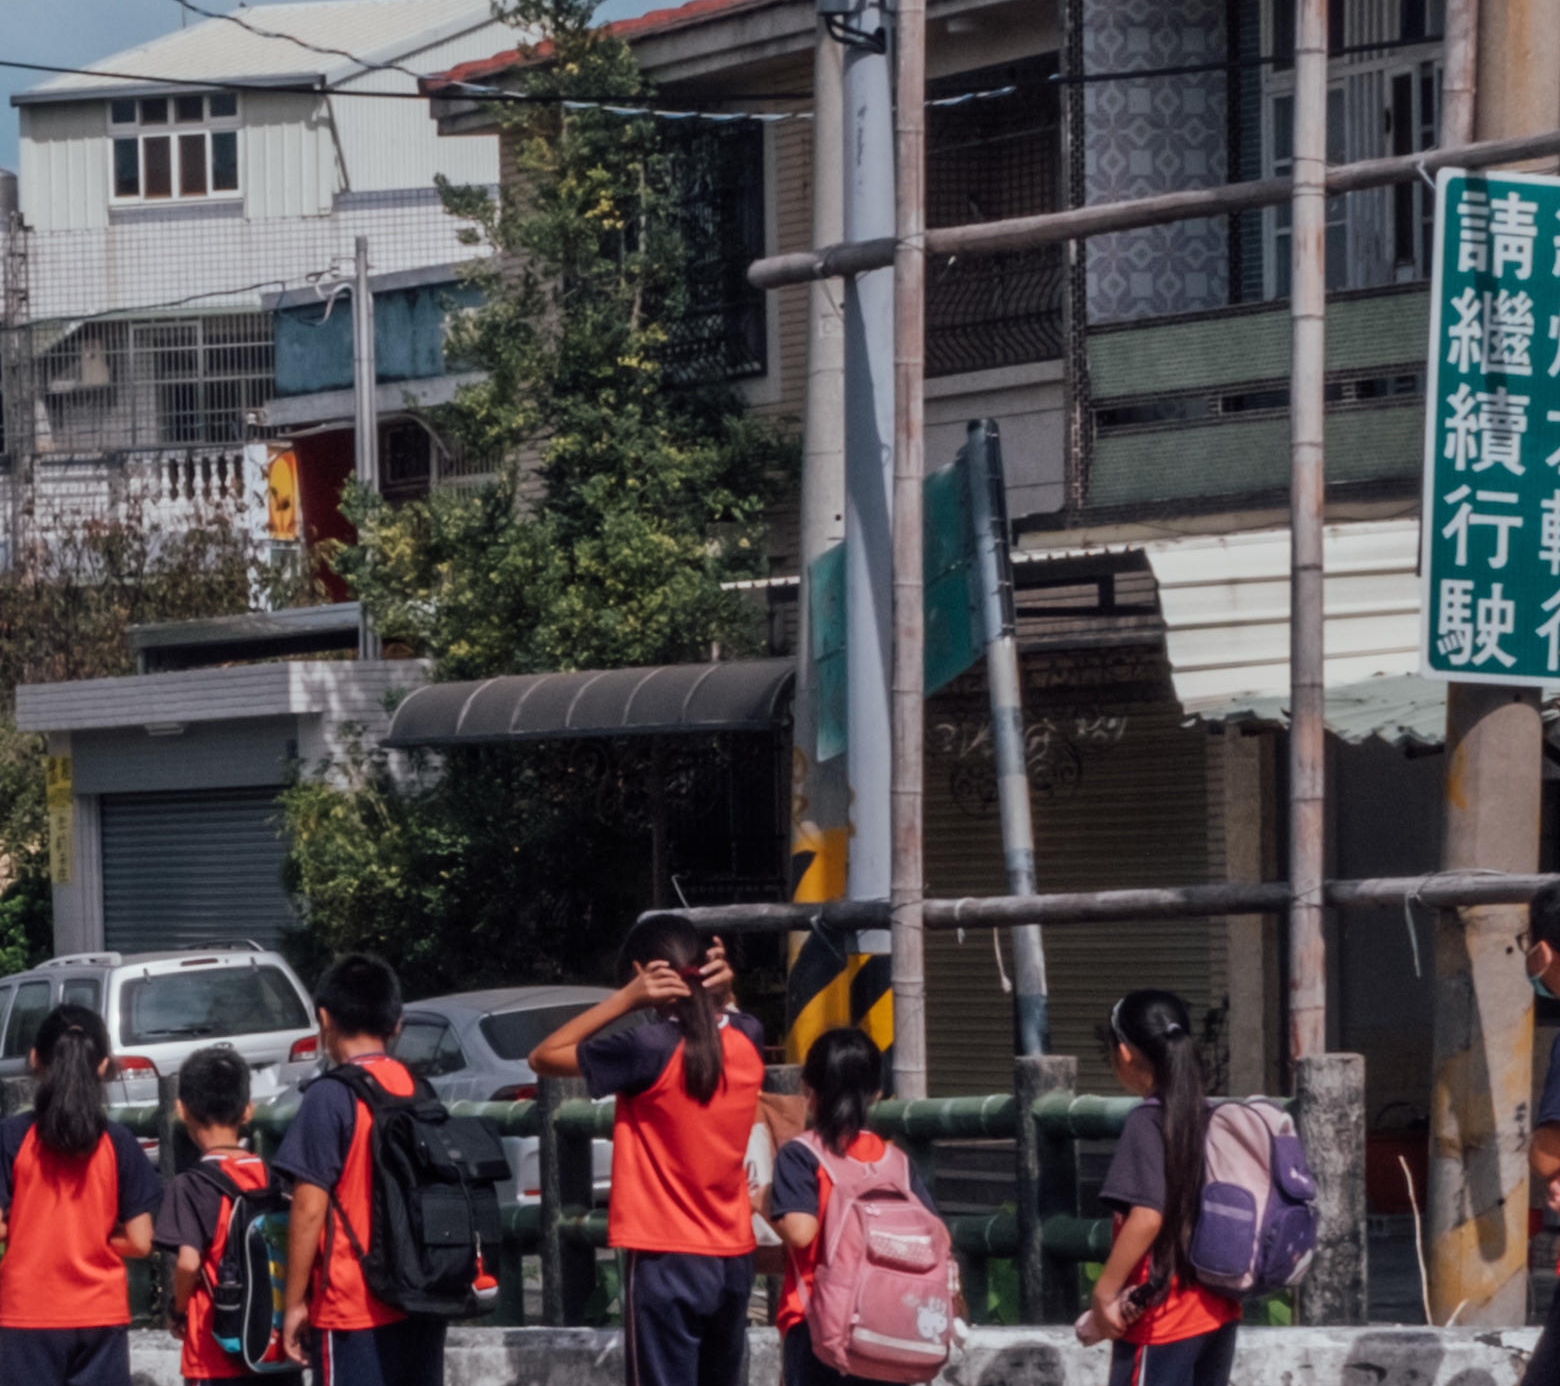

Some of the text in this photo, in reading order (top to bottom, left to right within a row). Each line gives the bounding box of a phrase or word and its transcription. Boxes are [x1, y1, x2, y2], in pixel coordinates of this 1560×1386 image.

[1436, 190, 1538, 669] 請繼續行駛
